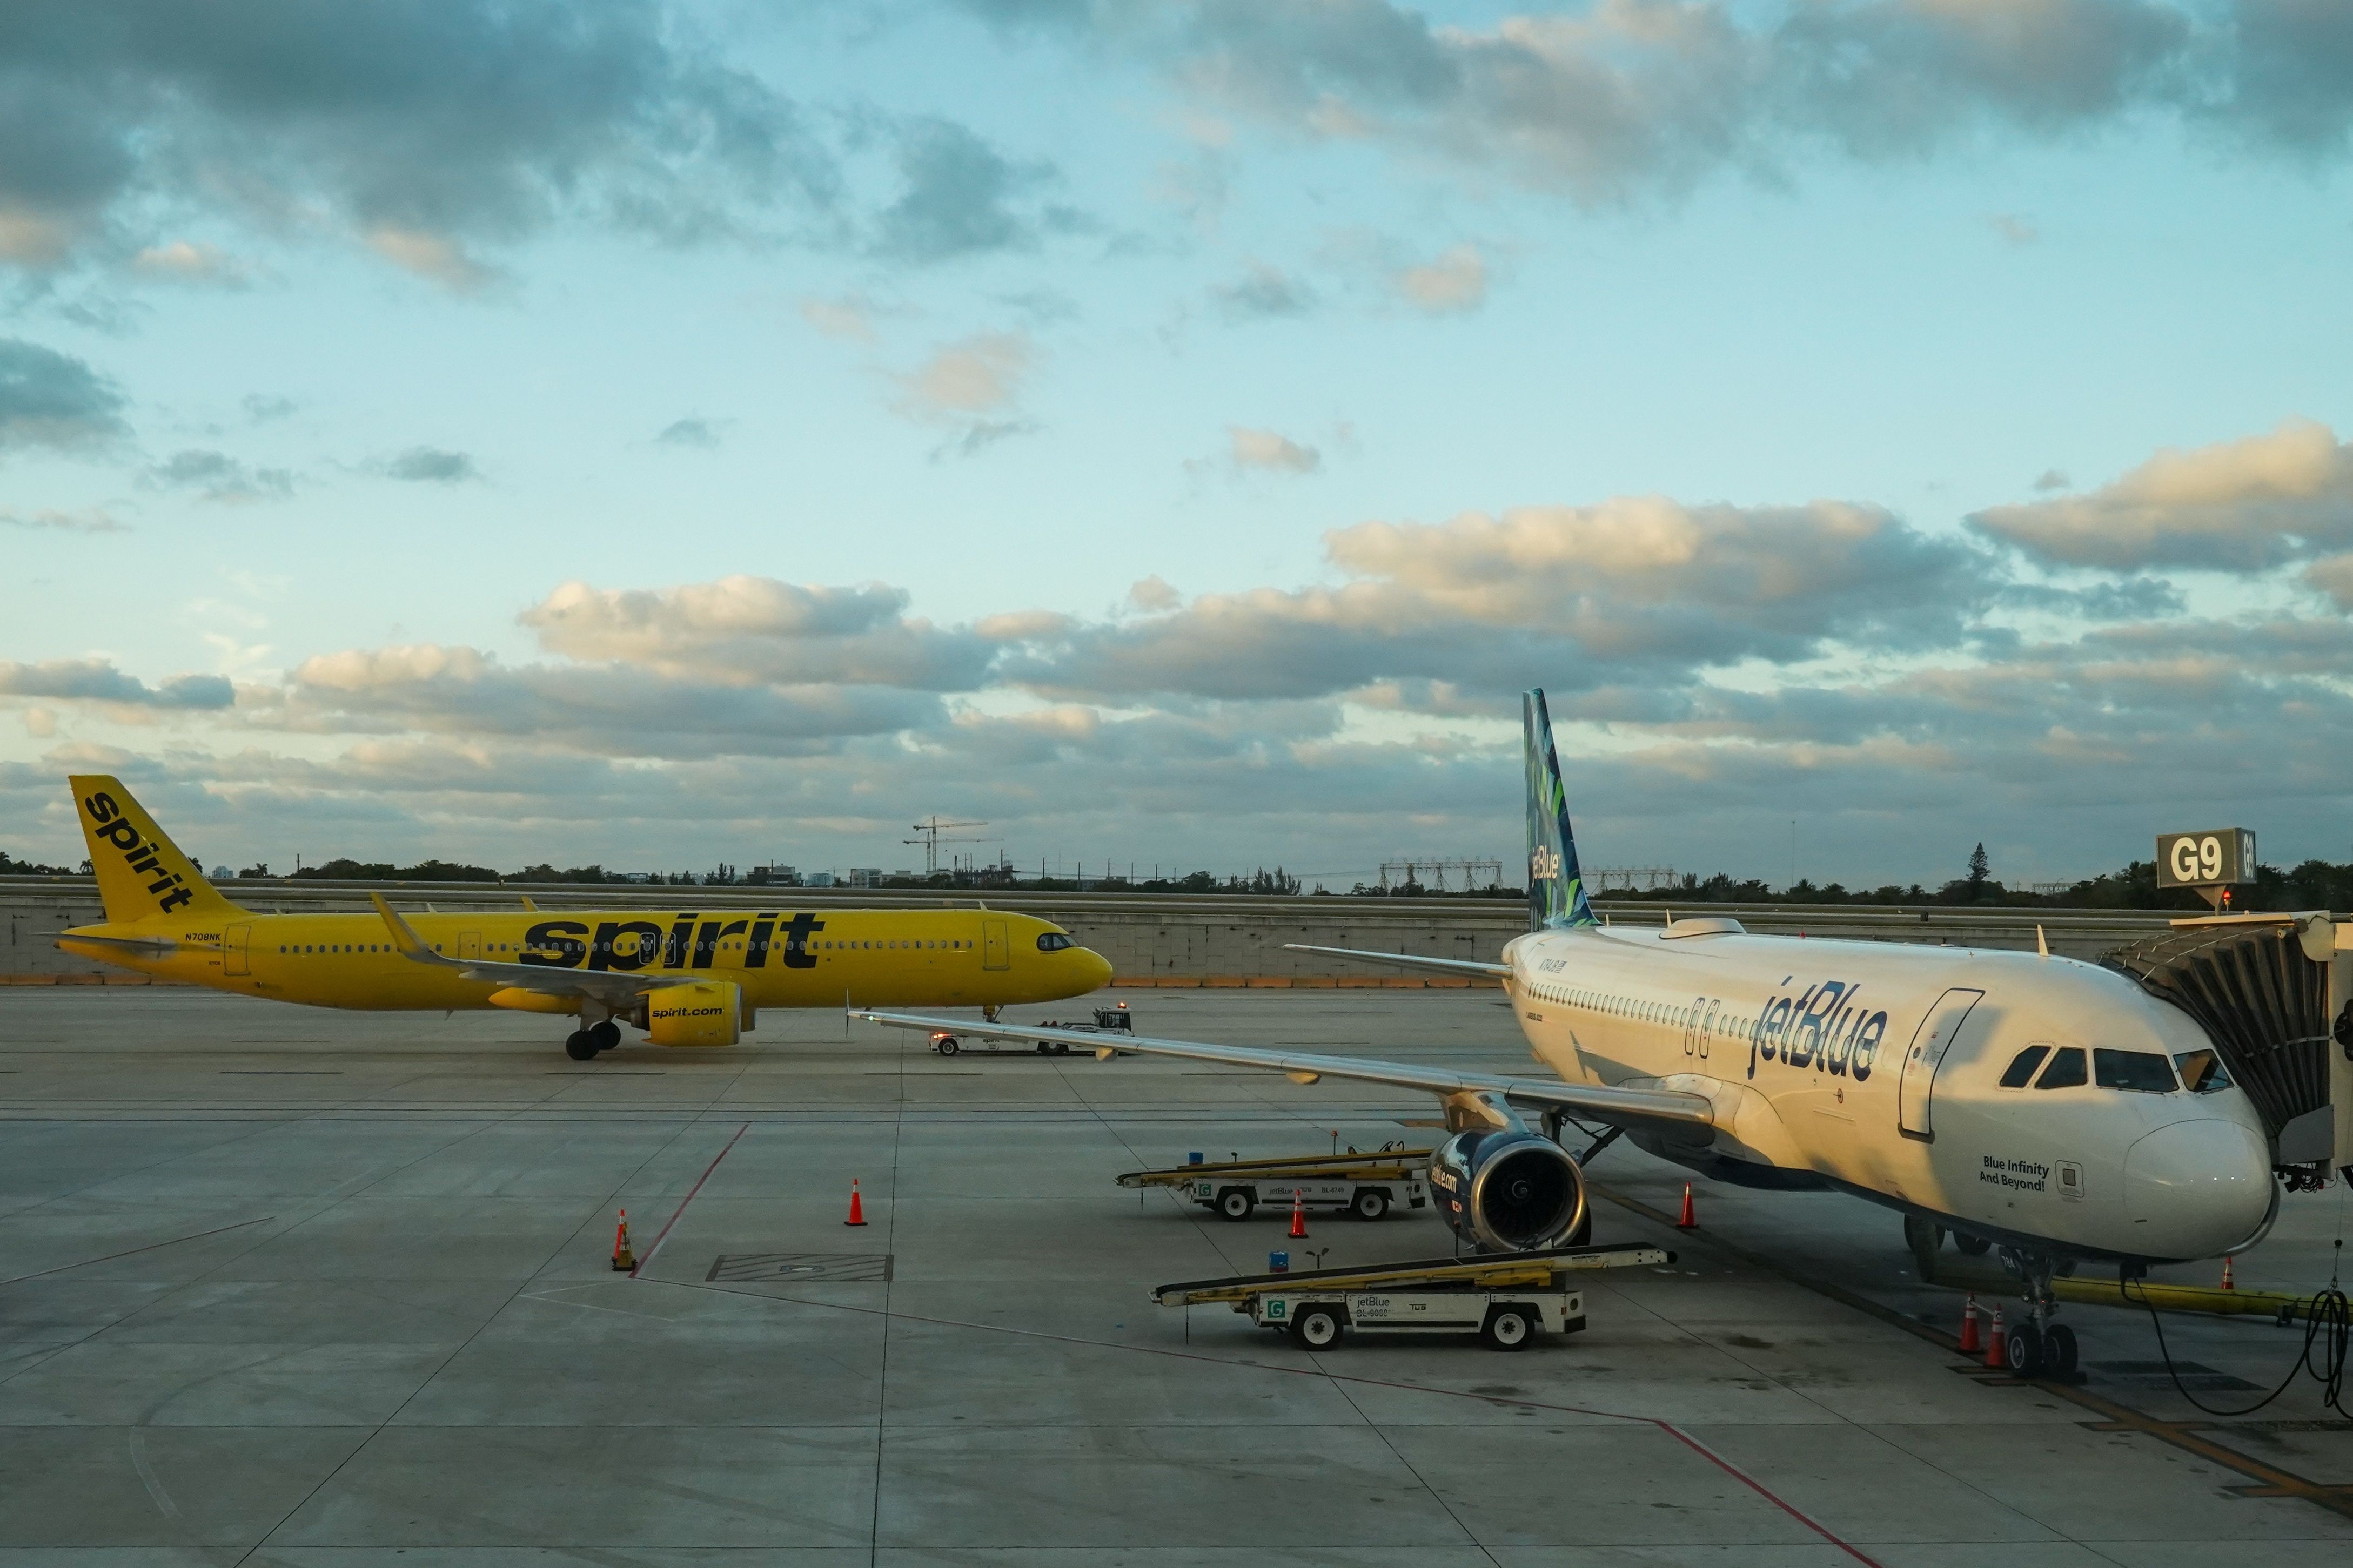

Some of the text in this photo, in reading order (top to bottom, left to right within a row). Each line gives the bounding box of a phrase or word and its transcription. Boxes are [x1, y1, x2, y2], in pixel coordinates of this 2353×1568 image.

[85, 792, 193, 914] spirit
[2171, 837, 2222, 881] G9
[2243, 833, 2254, 878] G9
[1532, 845, 1558, 888] jetBlue
[519, 913, 825, 971] spirit
[652, 1008, 722, 1019] spirit.com
[1748, 975, 1887, 1081] jetBlue
[1983, 1156, 2049, 1179] Blue Infinity
[1200, 1185, 1210, 1196] G
[1270, 1187, 1293, 1195] jetBlue
[1980, 1171, 2045, 1192] And Beyond!
[1270, 1302, 1282, 1317] G
[1357, 1297, 1390, 1307] jetBlue
